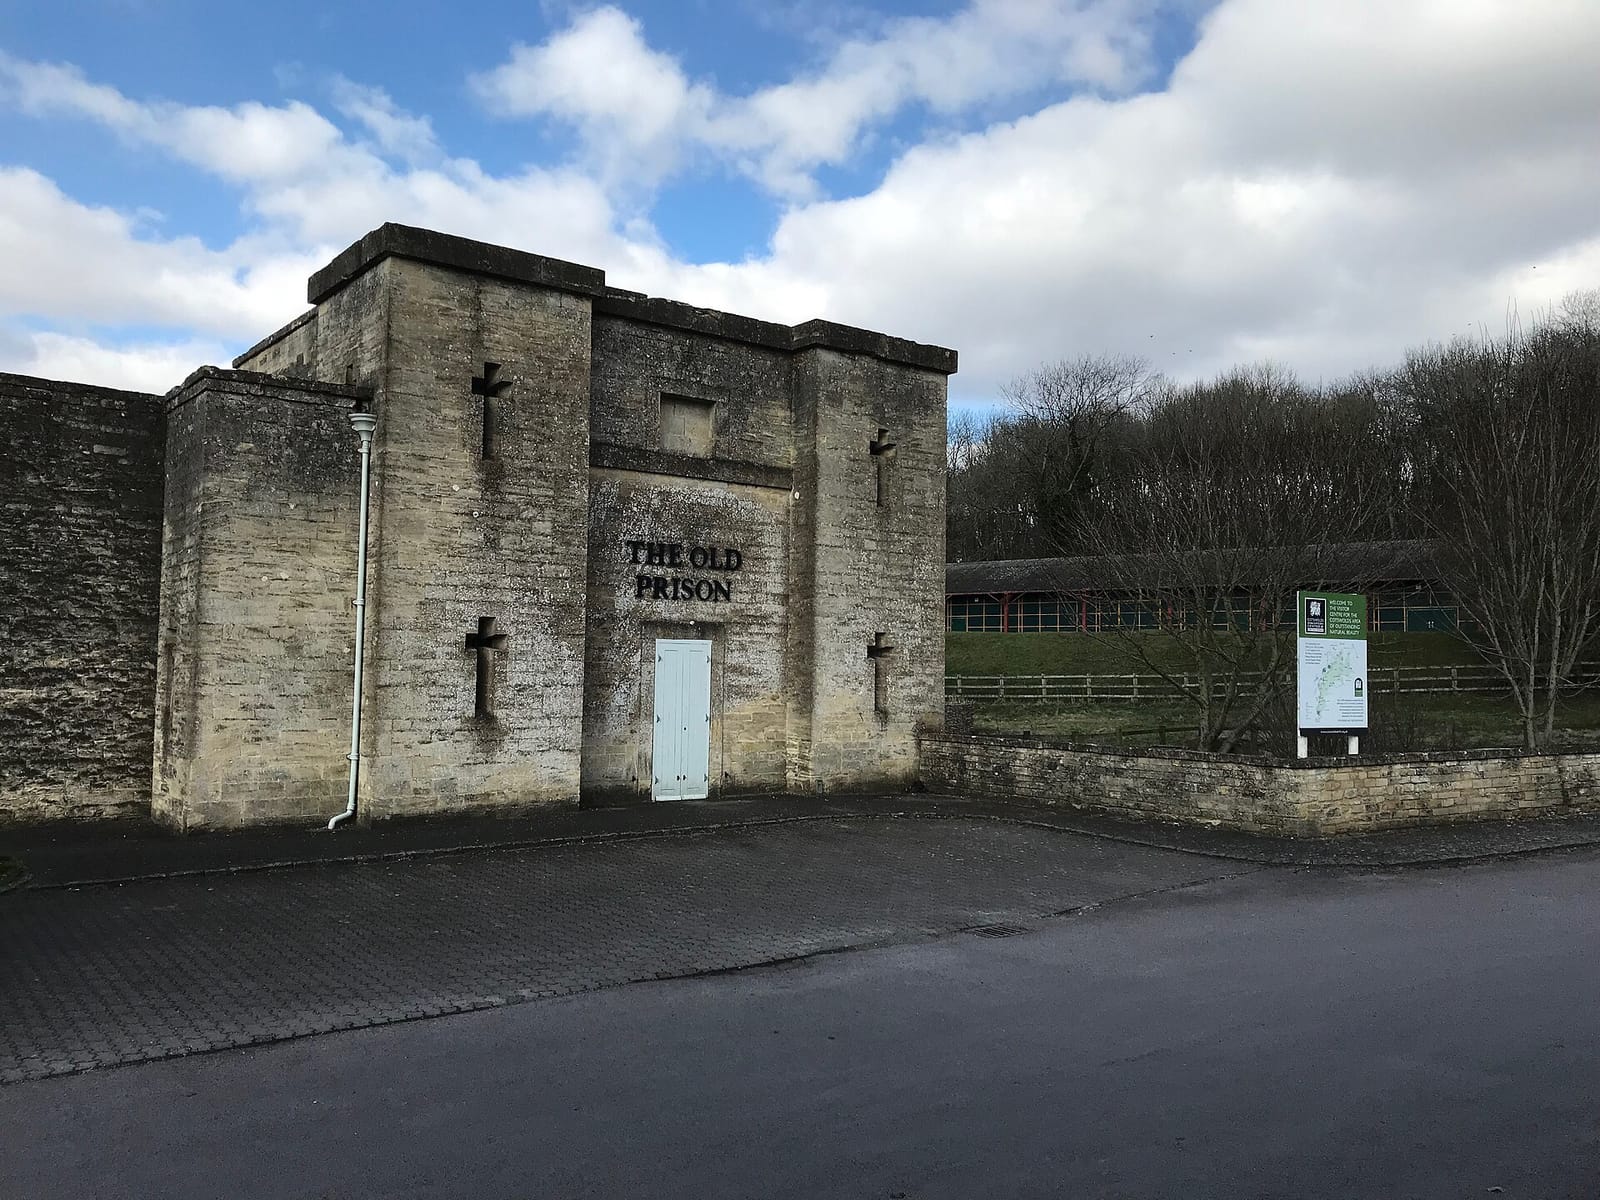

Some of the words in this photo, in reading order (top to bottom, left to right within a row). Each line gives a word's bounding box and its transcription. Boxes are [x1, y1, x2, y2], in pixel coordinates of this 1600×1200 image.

[628, 541, 682, 568] THE
[690, 547, 742, 570] OLD
[636, 576, 731, 602] PRISON
